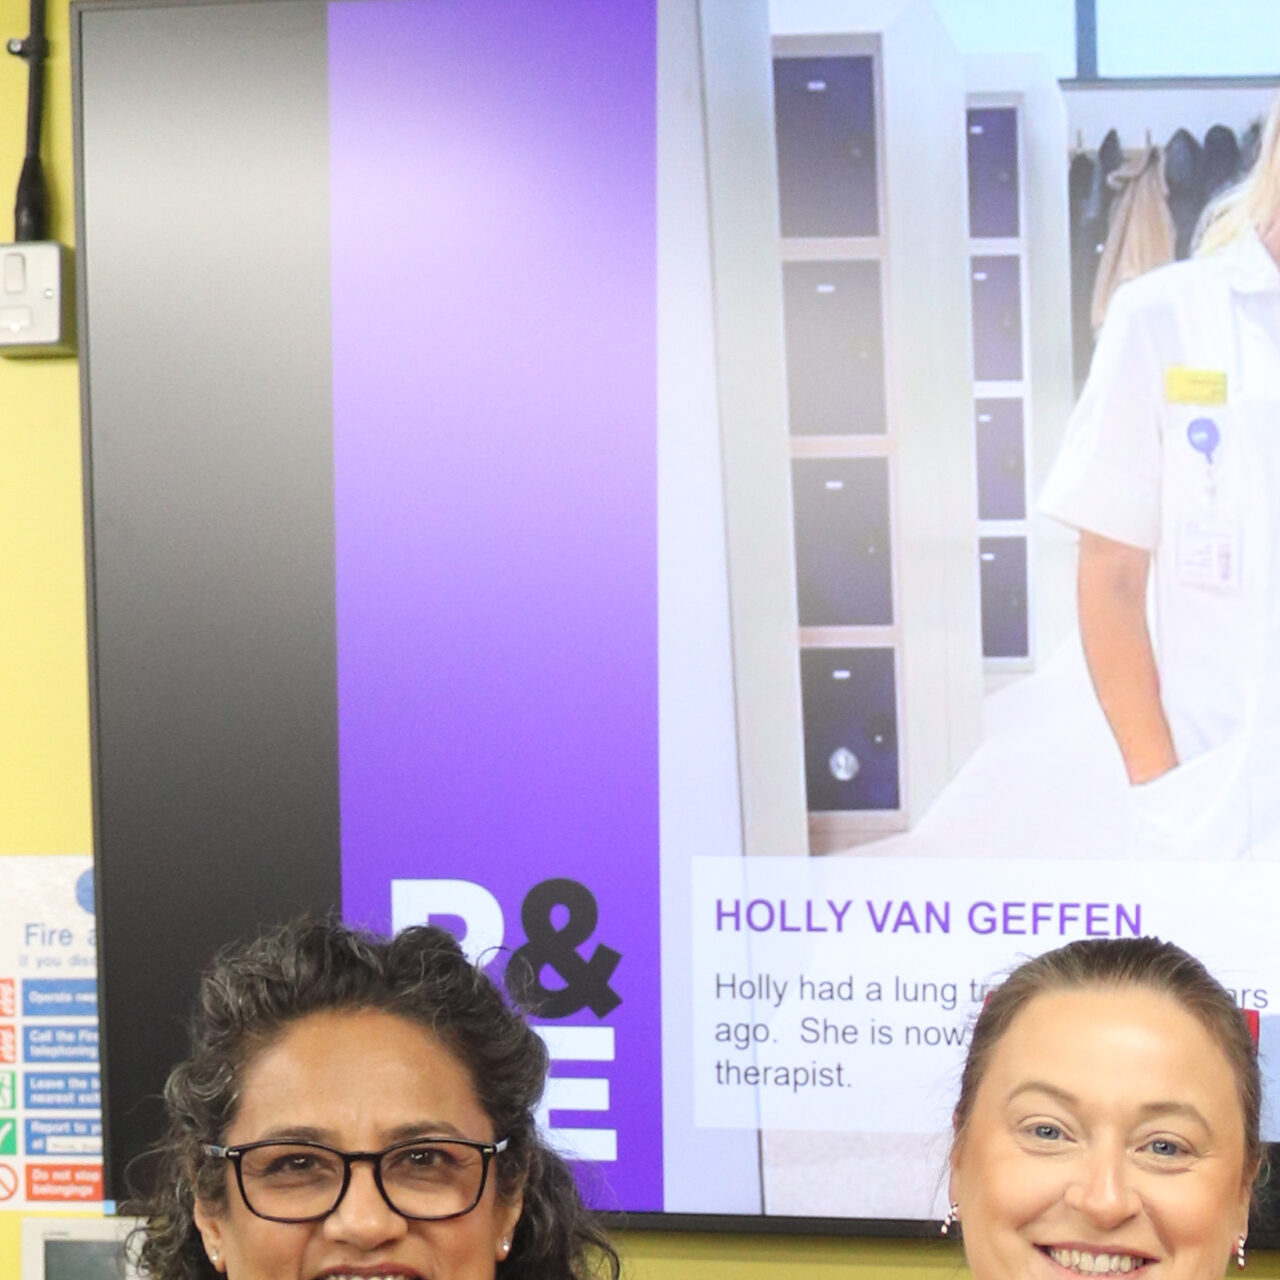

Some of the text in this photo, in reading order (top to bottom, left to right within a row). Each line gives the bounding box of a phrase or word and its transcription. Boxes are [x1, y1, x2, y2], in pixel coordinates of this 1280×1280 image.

[716, 898, 1142, 937] HOLLY VAN GEFFEN
[24, 922, 73, 947] Fire
[36, 955, 61, 970] you
[715, 972, 788, 1008] Holly
[799, 973, 854, 1002] had
[866, 980, 882, 1002] a
[895, 975, 958, 1011] lung
[29, 1029, 53, 1043] Call
[55, 1029, 77, 1043] the
[715, 1016, 967, 1050] ago. She is now
[29, 1076, 65, 1090] Leave
[67, 1076, 89, 1090] the
[715, 1060, 852, 1093] therapist.
[31, 1120, 71, 1135] Report
[73, 1121, 88, 1134] to
[32, 1167, 50, 1182] Do
[52, 1168, 71, 1182] not
